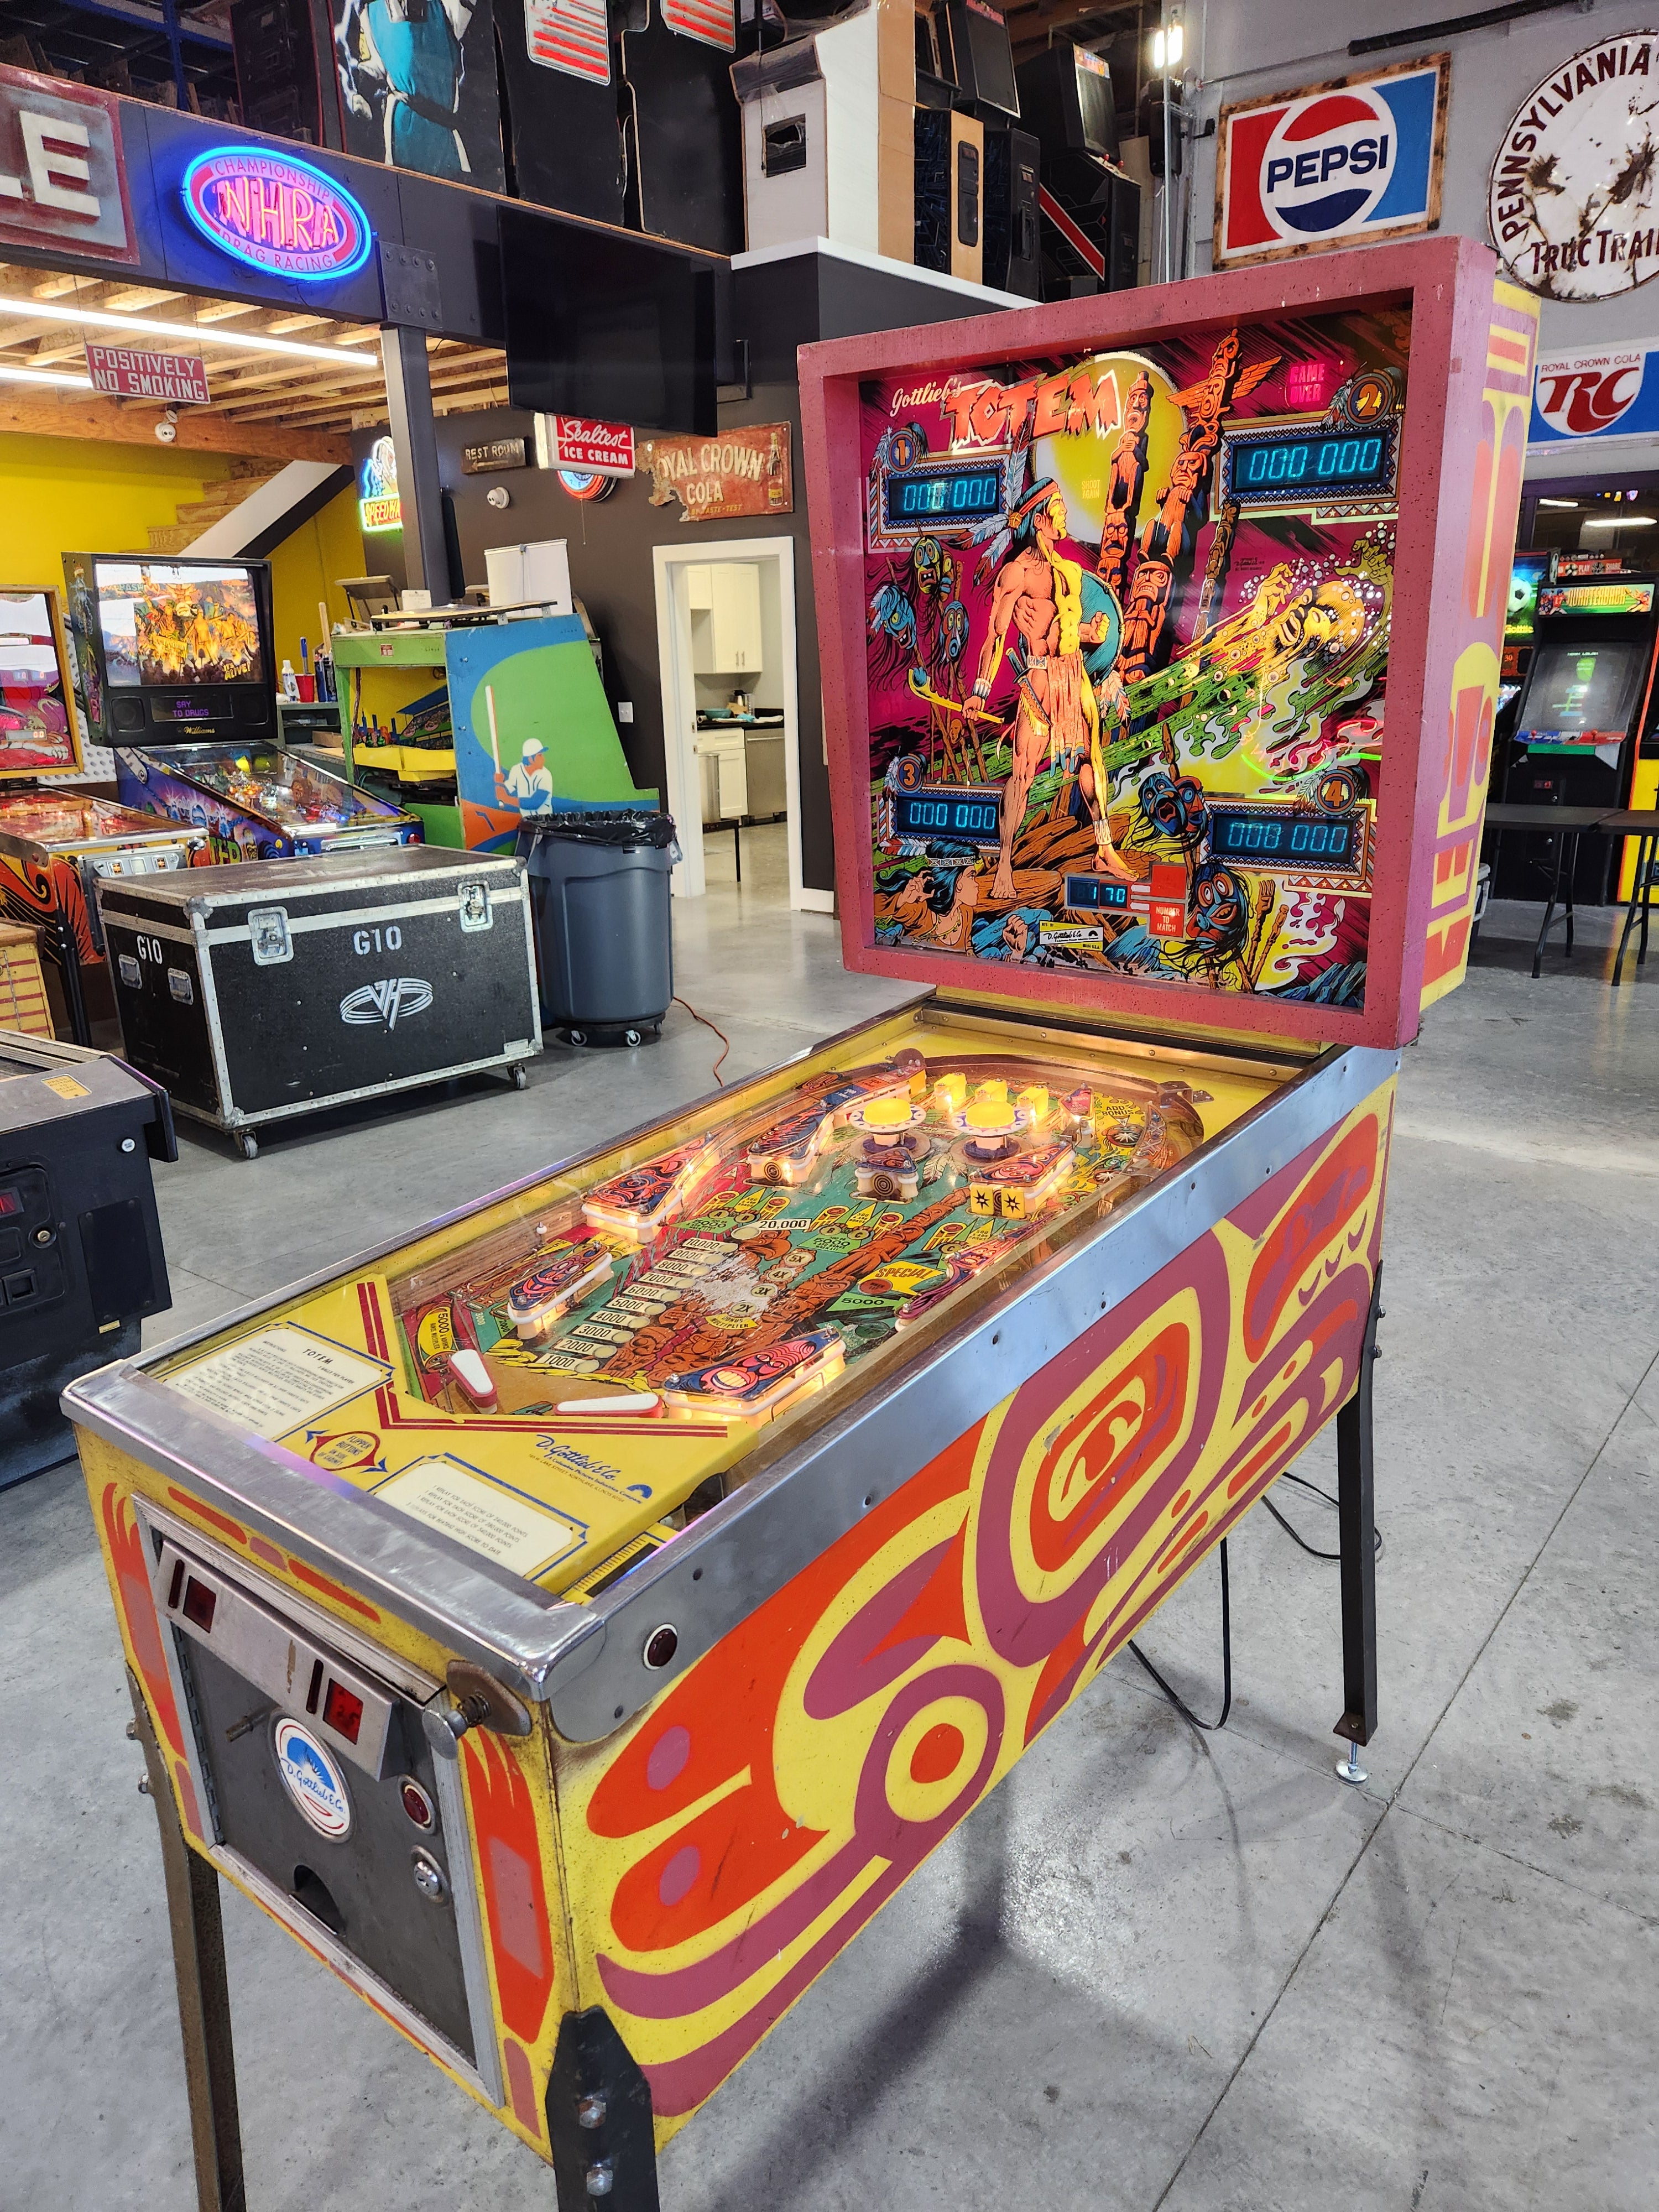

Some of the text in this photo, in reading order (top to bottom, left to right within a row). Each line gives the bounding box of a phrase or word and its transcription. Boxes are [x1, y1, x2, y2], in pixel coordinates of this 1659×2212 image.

[1496, 43, 1651, 242] PENNSYLVANIA
[1266, 134, 1389, 194] PEPSI
[215, 157, 331, 200] CHAMPIONSHIP
[216, 175, 339, 251] NHRA
[222, 232, 333, 270] DRAG RACING
[93, 348, 195, 377] POSITIVELY
[1541, 353, 1641, 373] ROYAL CROWN COLA
[1290, 363, 1325, 384] GAME
[93, 369, 205, 400] NO SMOKING
[890, 378, 963, 417] Gottlieb's
[1290, 384, 1321, 403] OVER
[1359, 383, 1379, 417] 2
[1540, 367, 1640, 433] RC
[942, 371, 1121, 447] TOTEM
[560, 419, 630, 449] Sealtest
[465, 446, 488, 460] REST
[564, 446, 628, 465] ICE CREAM
[896, 439, 907, 466] 1
[1249, 439, 1381, 481] 000 000
[656, 444, 764, 481] OYAL CROWN
[686, 480, 724, 505] COLA
[954, 477, 996, 508] 000
[1082, 479, 1100, 491] SHOOT
[1082, 489, 1100, 499] AGAIN
[365, 498, 401, 526] SPEEDWA
[1568, 586, 1627, 607] QUARTERBACK
[183, 726, 216, 734] Williams
[903, 764, 915, 786] 3
[1324, 780, 1344, 807] 4
[910, 802, 996, 829] 000 000
[1291, 824, 1349, 854] 000
[1107, 888, 1125, 903] 70
[1156, 906, 1180, 916] NUMBER
[1157, 922, 1176, 933] MATCH
[1162, 915, 1170, 924] TO
[693, 1219, 727, 1228] 5000
[759, 1219, 808, 1229] 20,000
[686, 1238, 721, 1250] 10,000
[813, 1237, 851, 1246] 5000
[791, 1254, 805, 1262] 5X
[658, 1261, 689, 1272] 8000
[875, 1266, 933, 1279] SPECIAL
[643, 1273, 674, 1284] 7000
[772, 1271, 786, 1280] 4X
[628, 1285, 660, 1297] 6000
[754, 1286, 770, 1296] 3X
[612, 1297, 645, 1311] 5000
[738, 1303, 753, 1313] 2X
[842, 1297, 884, 1306] 5000
[438, 1313, 450, 1333] 5000
[476, 1312, 486, 1326] 3000
[499, 1319, 510, 1332] 2000
[594, 1311, 628, 1324] 4000
[578, 1324, 612, 1338] 3000
[561, 1339, 595, 1352] 2000
[302, 1348, 335, 1365] TOTEM
[543, 1354, 575, 1368] 1000
[347, 1435, 372, 1449] FLIPPER
[536, 1434, 555, 1450] D.
[544, 1445, 603, 1469] Gottlieb
[552, 1458, 575, 1471] Columbia
[601, 1469, 621, 1481] Co.
[296, 1769, 328, 1801] Gottlieb
